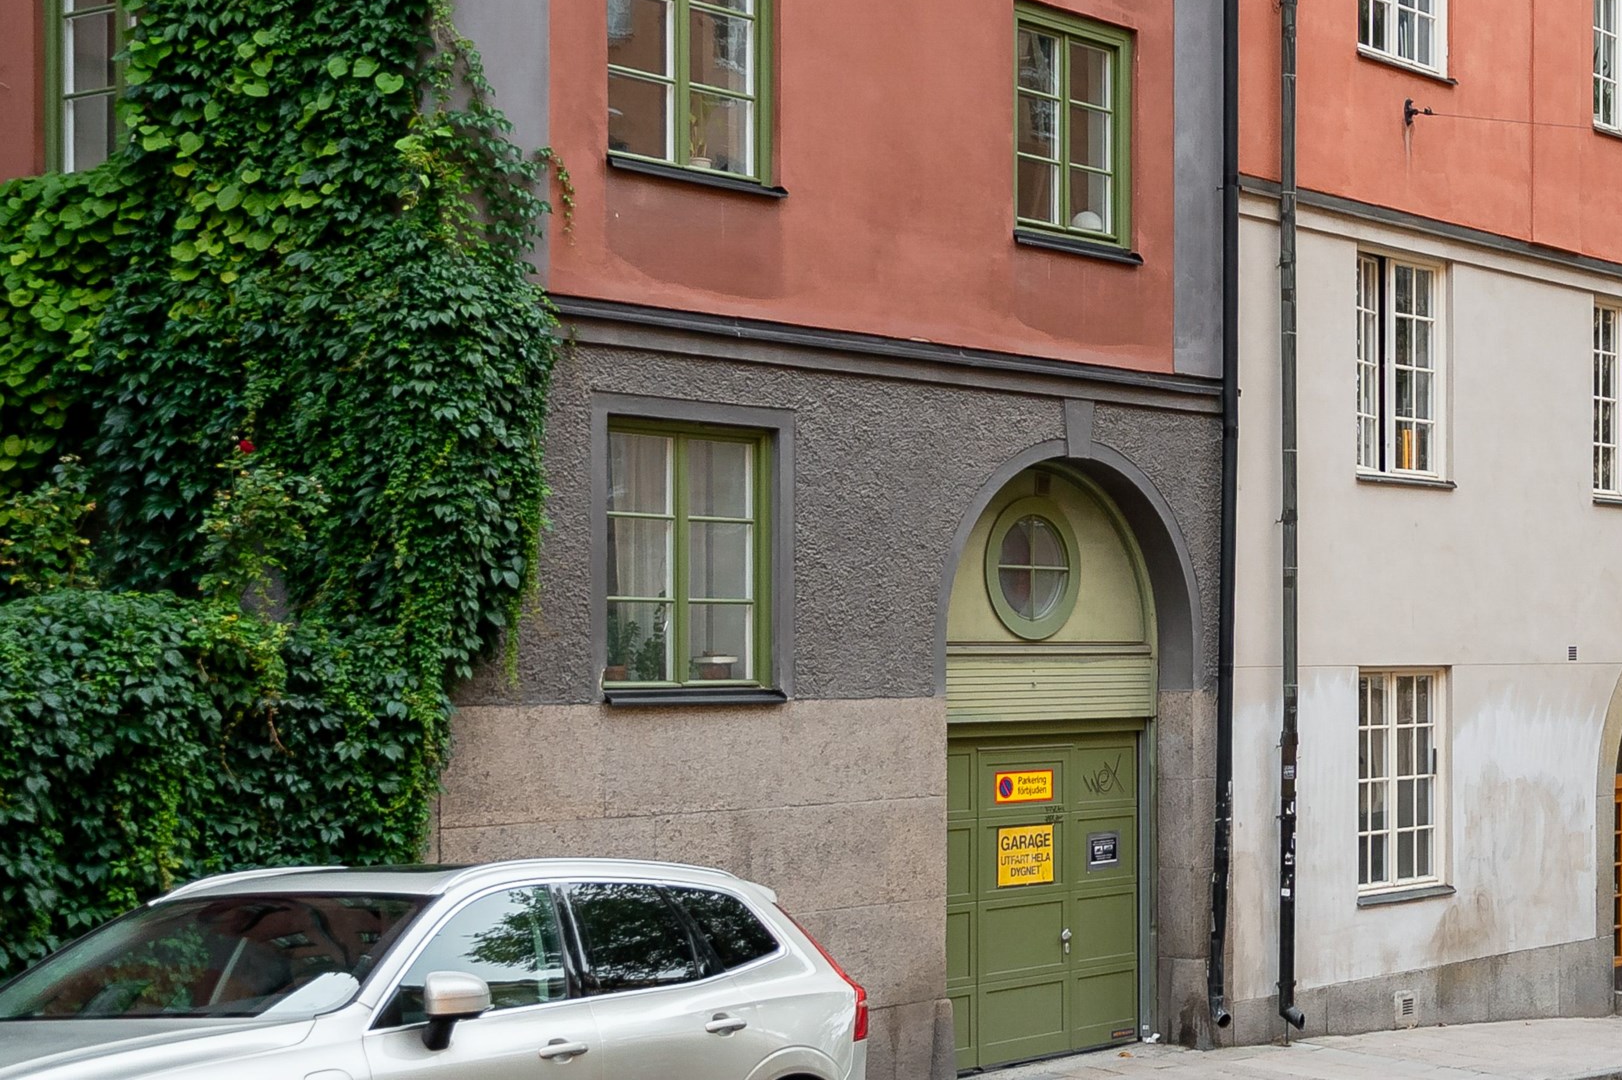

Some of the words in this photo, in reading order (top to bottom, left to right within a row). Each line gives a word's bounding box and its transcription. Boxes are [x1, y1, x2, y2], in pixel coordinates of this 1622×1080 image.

[1017, 775, 1047, 785] Parkering
[1017, 785, 1047, 796] förbjuden
[1001, 832, 1052, 851] GARAGE
[1000, 854, 1030, 866] UTFART
[1031, 852, 1051, 863] HELA
[1010, 865, 1041, 877] DYGNET
